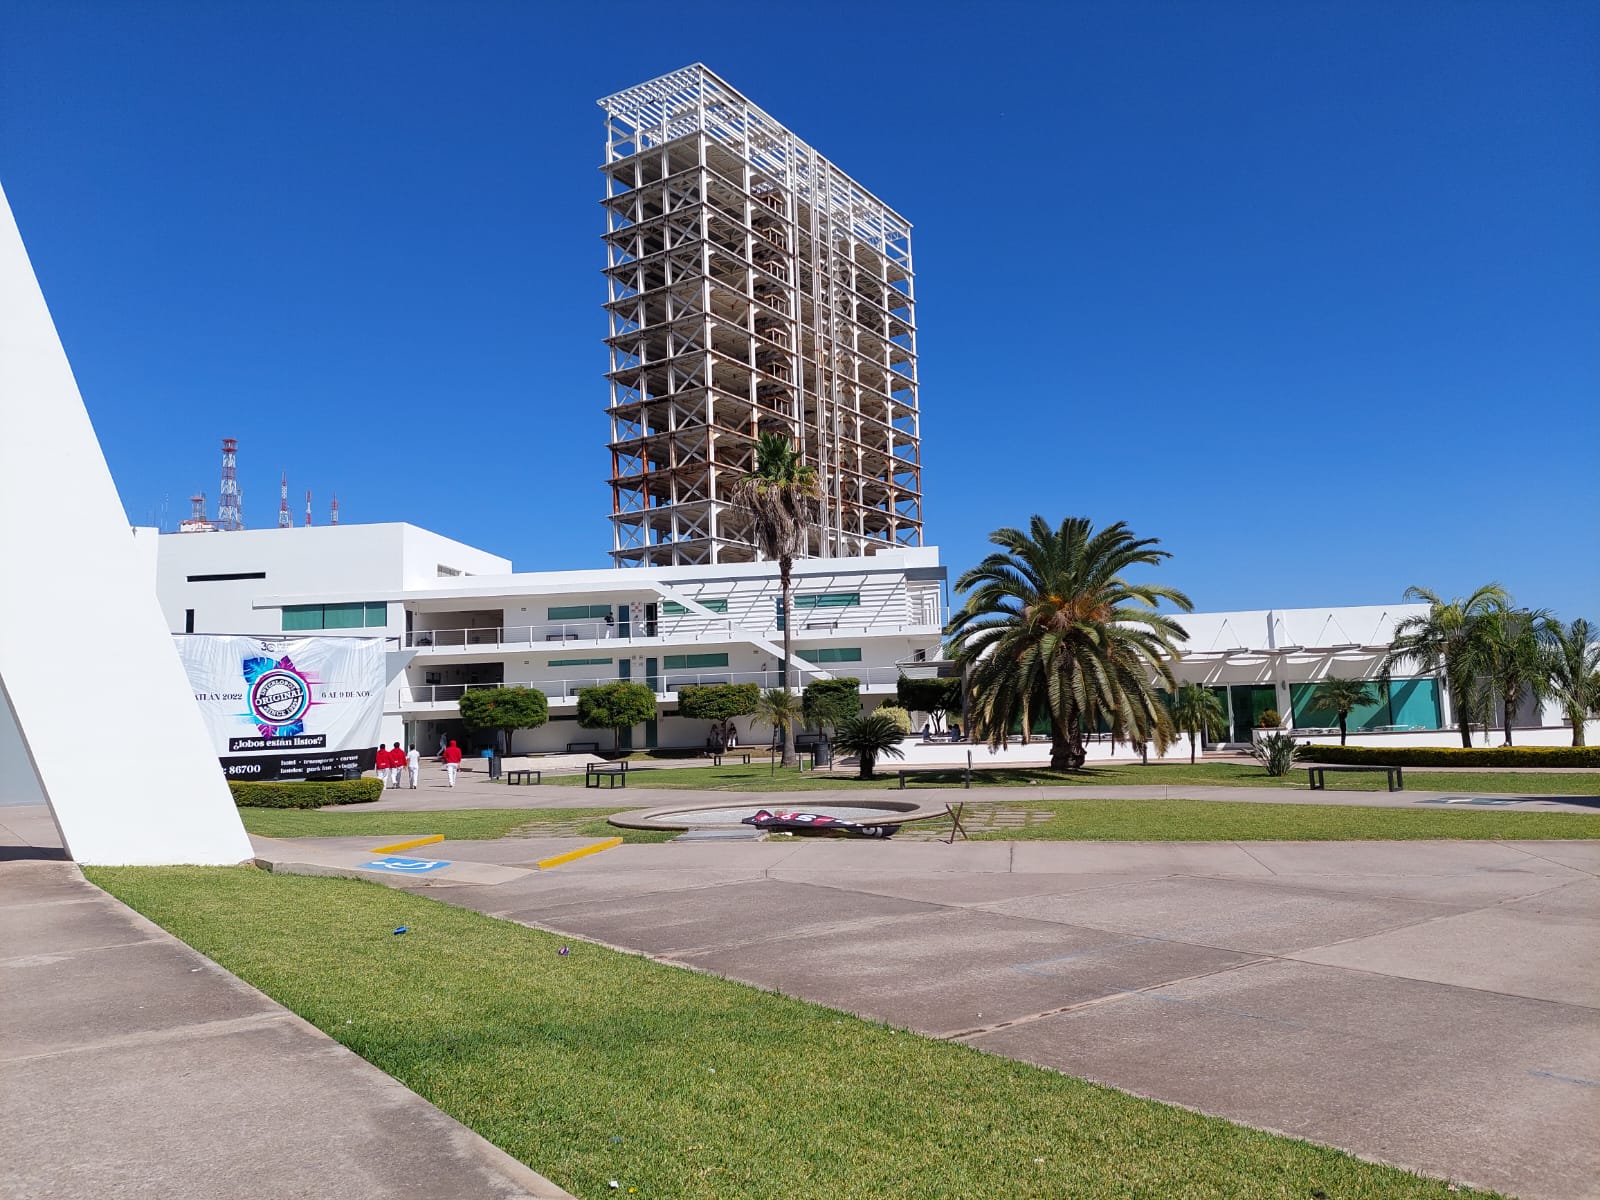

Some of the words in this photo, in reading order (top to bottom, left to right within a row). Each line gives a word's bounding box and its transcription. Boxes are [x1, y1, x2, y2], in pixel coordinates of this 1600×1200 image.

[222, 693, 243, 701] 2022
[255, 689, 304, 706] ORIGINAL
[233, 739, 265, 751] ¿lobos
[266, 738, 292, 747] están
[293, 736, 323, 747] listos?
[228, 764, 261, 775] 86700
